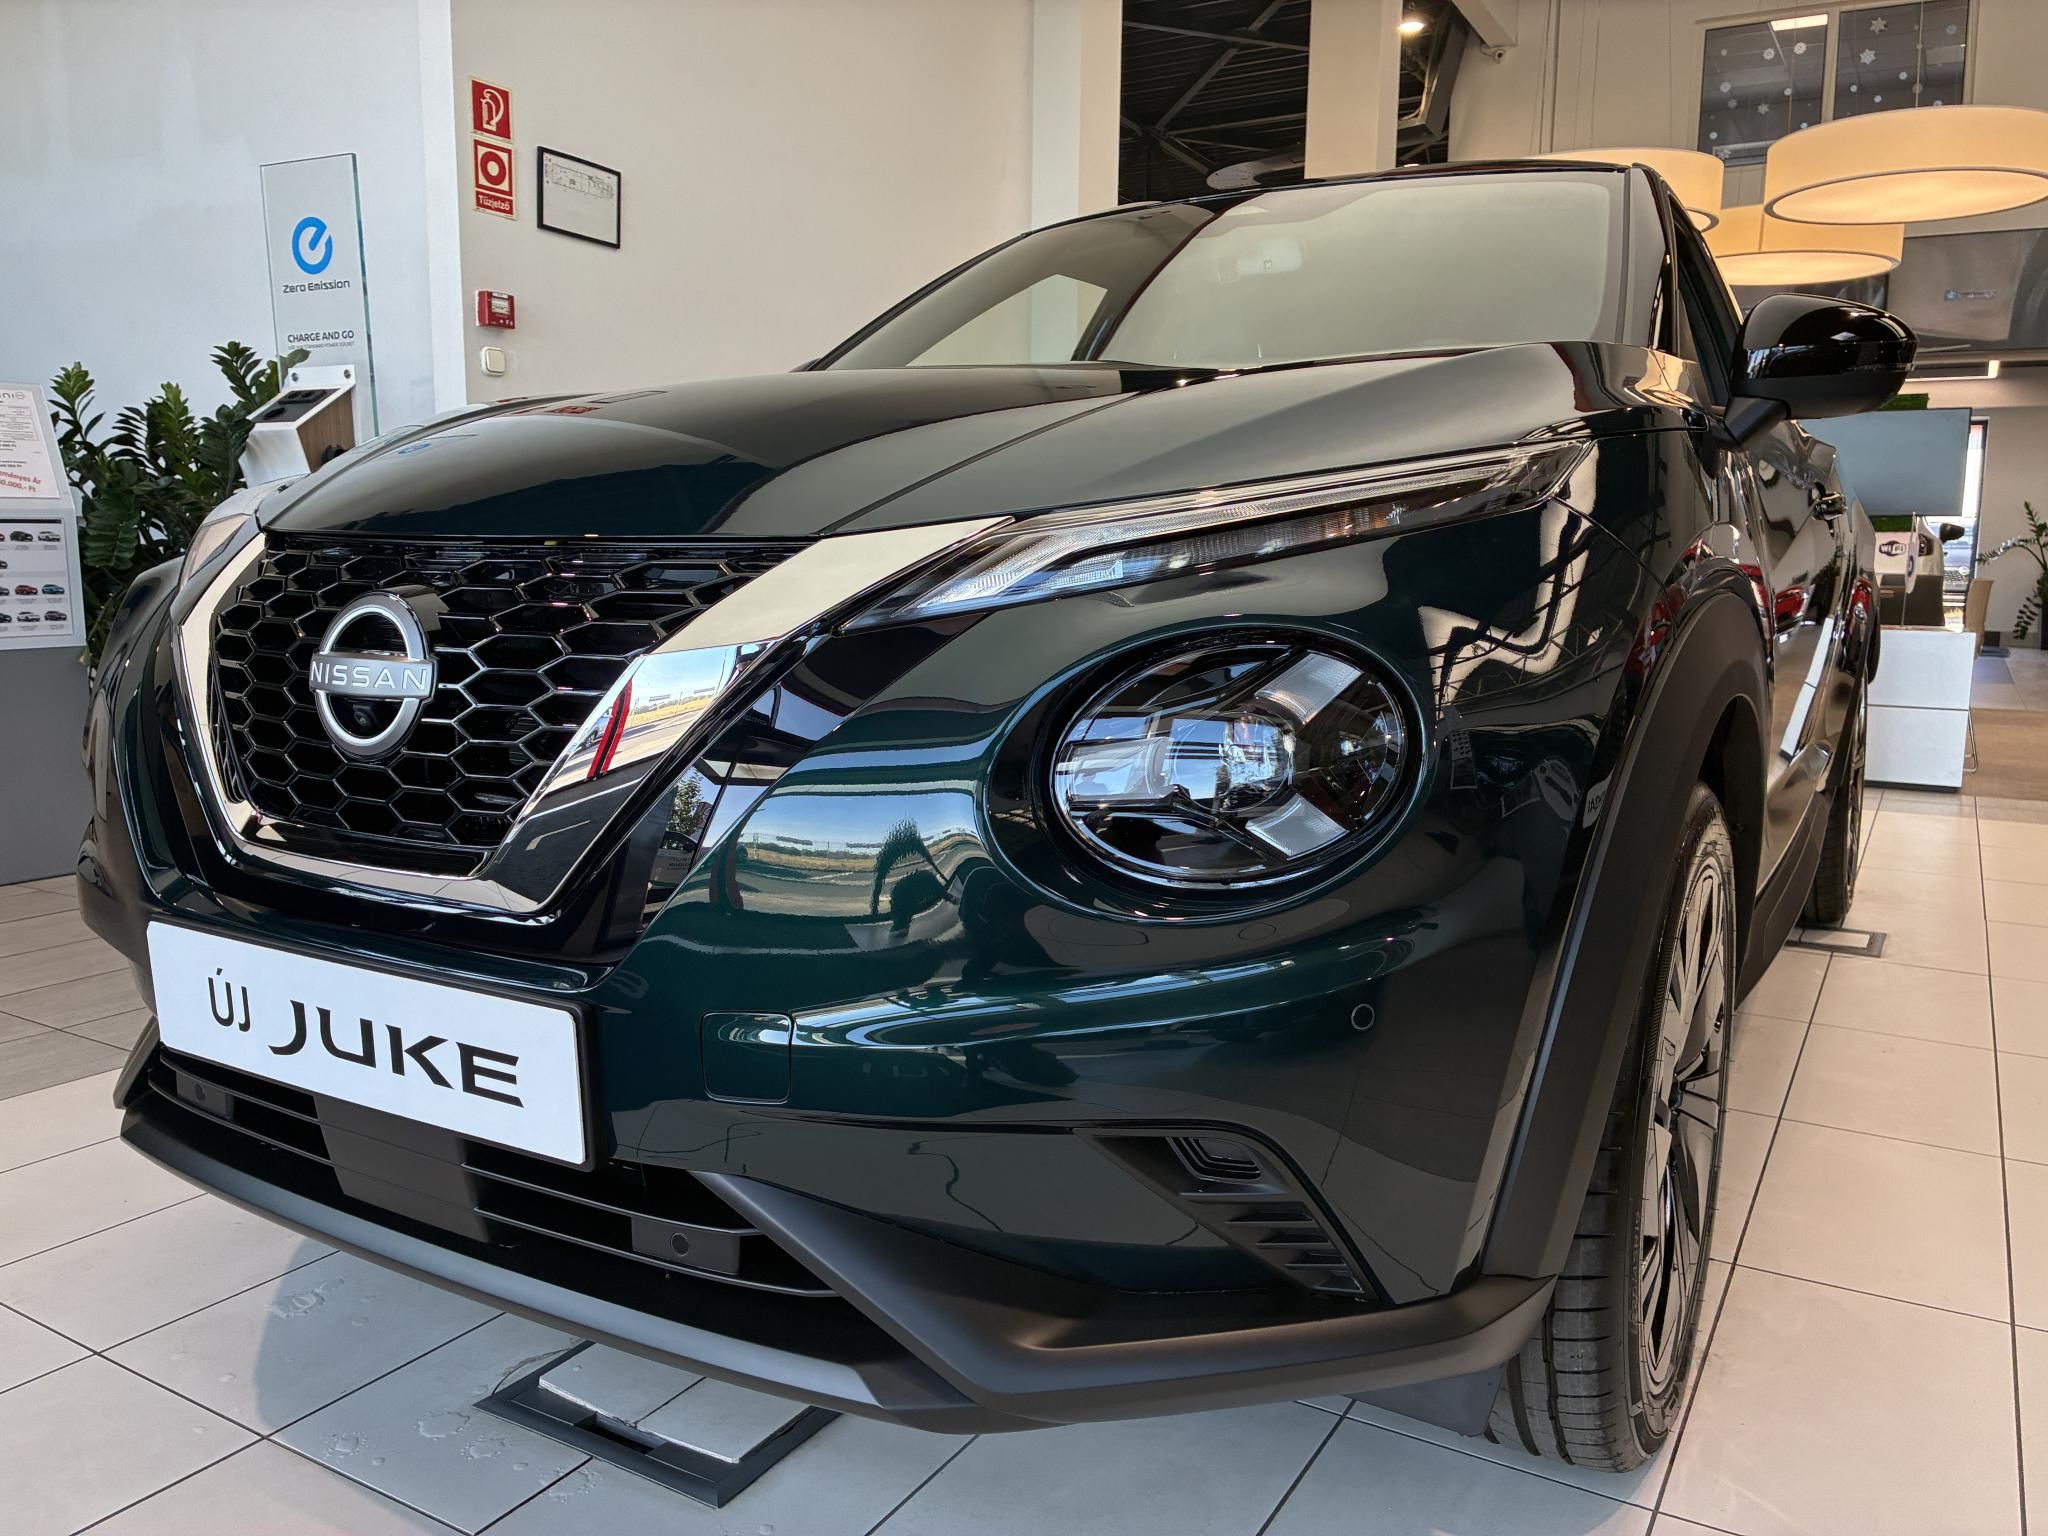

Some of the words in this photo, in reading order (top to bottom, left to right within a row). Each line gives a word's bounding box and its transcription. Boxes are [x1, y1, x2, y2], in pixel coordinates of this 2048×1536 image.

[478, 194, 510, 211] Tűzjelző
[282, 284, 306, 293] Zero
[307, 279, 350, 291] Emission
[288, 332, 320, 343] CHARGE
[322, 331, 340, 341] AND
[342, 330, 354, 339] GO
[310, 660, 428, 691] NISSAN
[207, 967, 251, 1033] ÚJ
[268, 999, 525, 1109] JUKE
